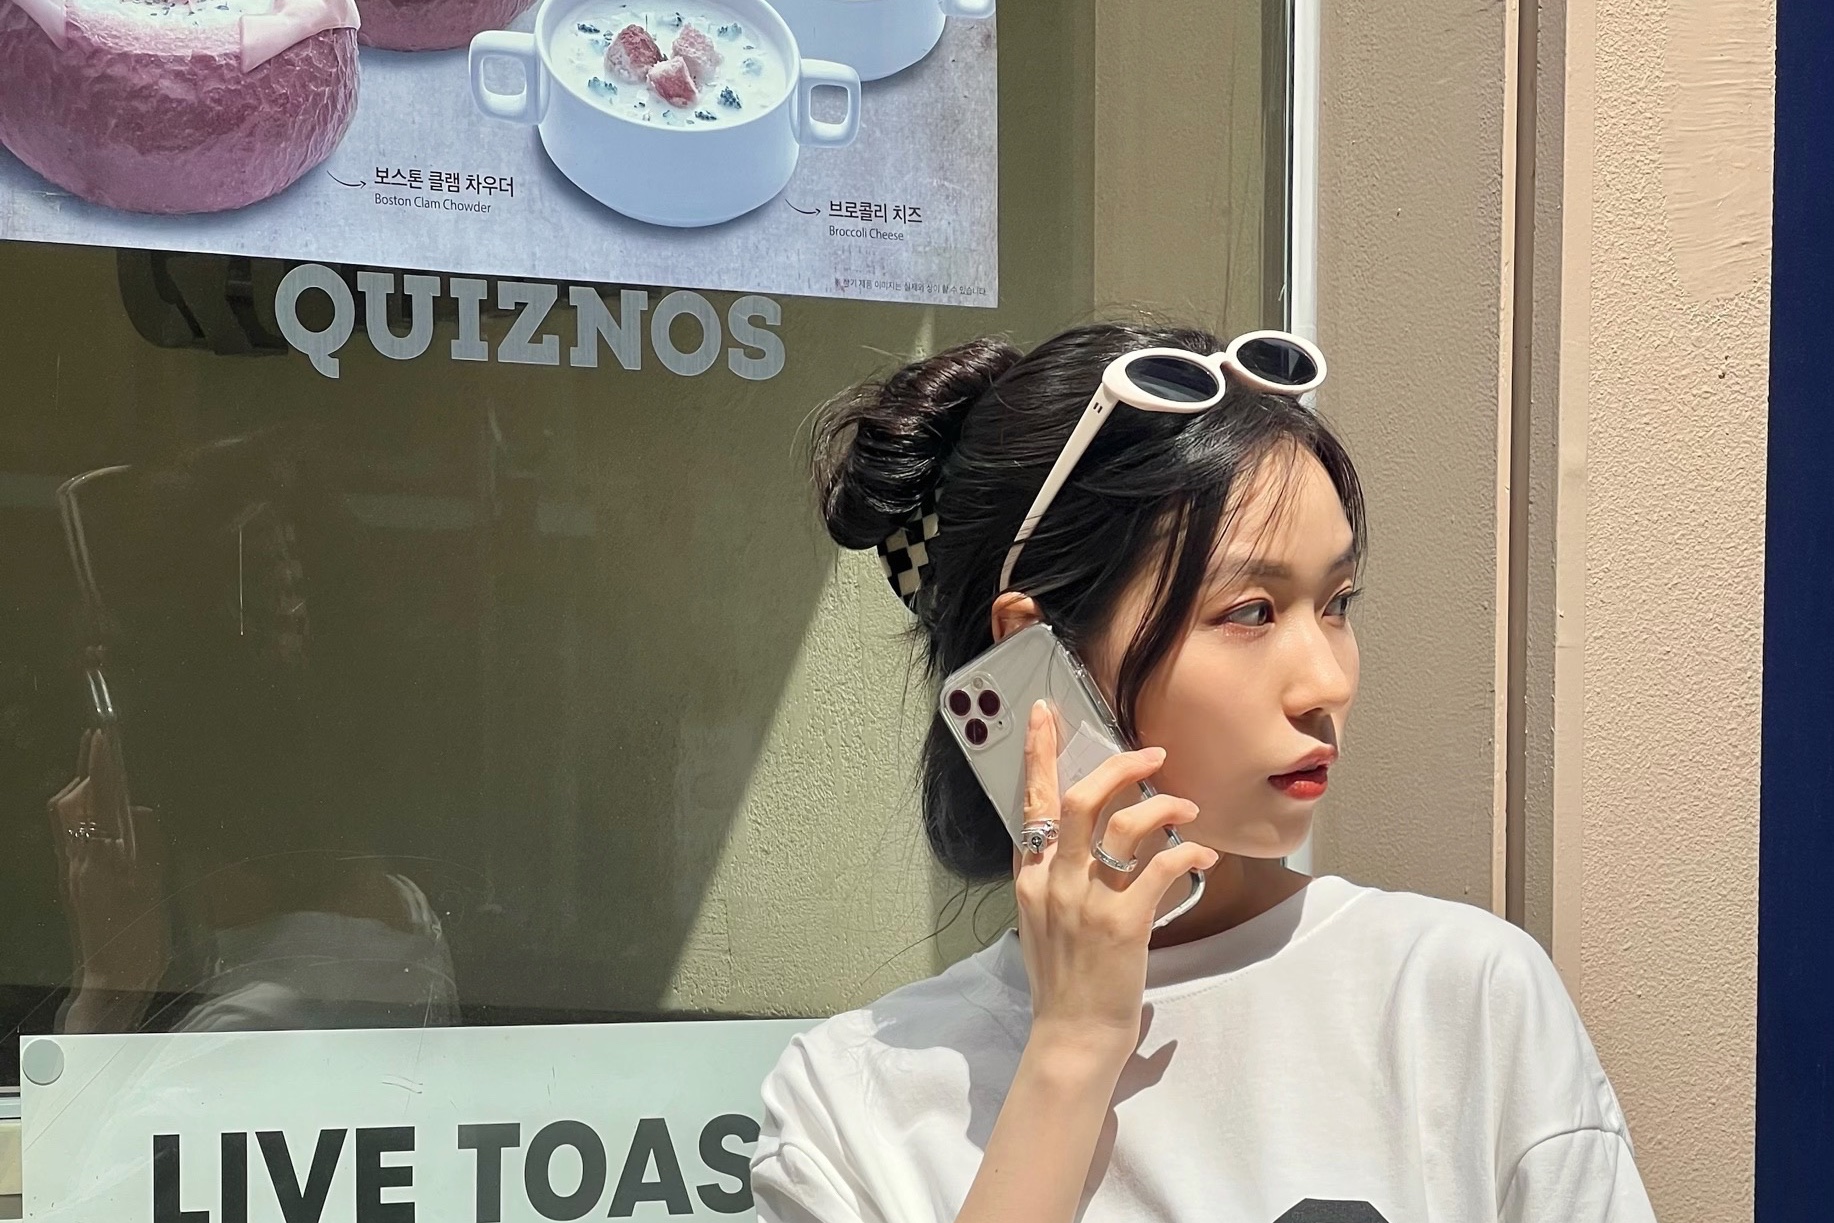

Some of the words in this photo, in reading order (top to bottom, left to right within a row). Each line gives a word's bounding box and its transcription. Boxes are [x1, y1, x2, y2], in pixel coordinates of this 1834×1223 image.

[374, 166, 423, 190] 보스톤
[428, 171, 460, 193] 클램
[465, 174, 514, 198] 차우더
[374, 193, 412, 207] Boston
[413, 196, 441, 209] Clam
[443, 199, 491, 213] Chowder
[828, 200, 888, 223] 브로콜리
[892, 205, 923, 224] 치즈
[829, 225, 868, 239] Broccoli
[869, 228, 904, 241] Cheese
[275, 263, 786, 380] QUIZNOS
